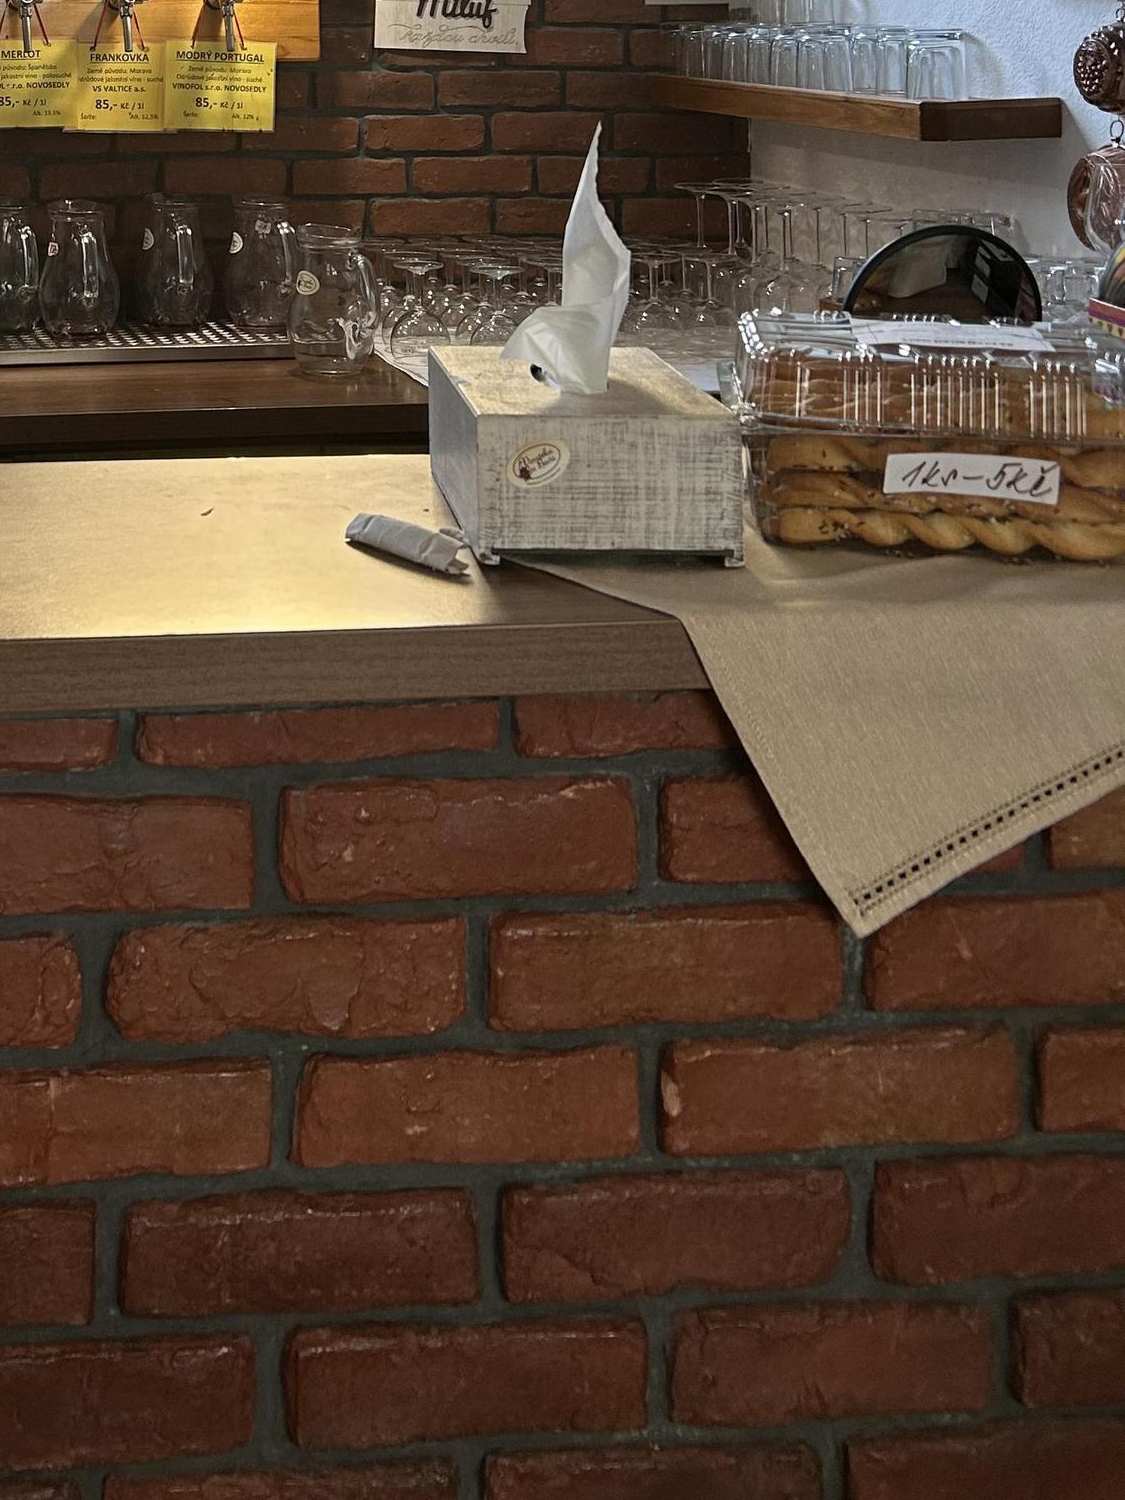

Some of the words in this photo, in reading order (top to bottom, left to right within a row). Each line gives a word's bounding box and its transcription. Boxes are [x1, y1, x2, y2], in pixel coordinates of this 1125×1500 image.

[90, 53, 149, 62] FRANKOVKA
[176, 50, 212, 60] MODRÝ
[214, 52, 265, 63] PORTUGAL
[26, 81, 70, 89] NOVOSEDLY
[224, 85, 267, 93] NOVOSEDLY
[95, 99, 118, 111] 85,-
[195, 97, 217, 109] 85,-
[220, 101, 229, 109] Kč
